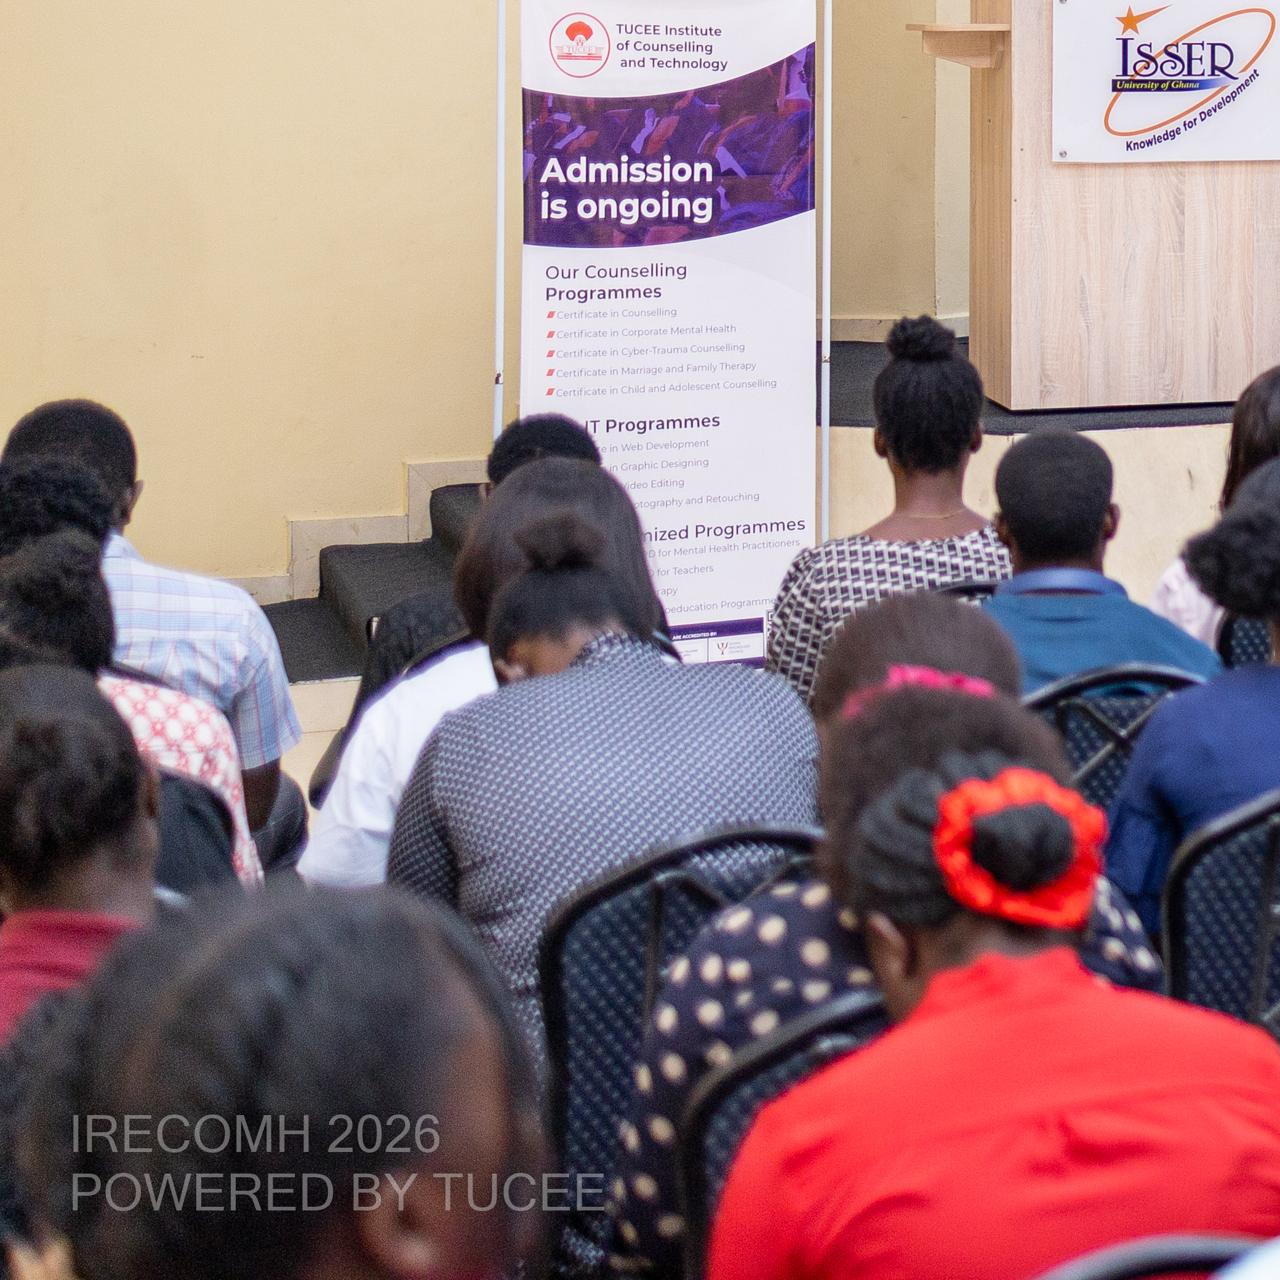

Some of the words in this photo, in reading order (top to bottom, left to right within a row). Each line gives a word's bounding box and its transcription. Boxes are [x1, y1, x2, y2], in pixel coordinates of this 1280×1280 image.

[616, 24, 660, 35] TUCEE
[666, 25, 721, 36] Institute
[617, 40, 629, 50] of
[634, 41, 712, 55] Counselling
[621, 57, 645, 67] and
[650, 58, 727, 71] Technology
[1116, 37, 1240, 80] ISSER
[1116, 80, 1159, 91] University
[1161, 80, 1170, 91] of
[1171, 80, 1200, 89] Ghana
[1126, 126, 1182, 152] Knowledge
[1183, 117, 1198, 131] for
[1199, 69, 1260, 122] Development
[540, 155, 712, 183] Admission
[541, 191, 568, 219] is
[577, 190, 712, 224] ongoing
[546, 266, 579, 279] Our
[585, 263, 686, 279] Counselling
[546, 288, 661, 303] Programmes
[557, 310, 608, 319] Certificate
[622, 307, 677, 318] Counselling
[556, 330, 607, 339] Certificate
[622, 328, 668, 337] Corporate
[671, 325, 703, 335] Mental
[706, 324, 736, 333] Health
[556, 349, 607, 358] Certificate
[610, 348, 618, 356] in
[622, 346, 688, 357] Cyber-Trauma
[690, 344, 745, 352] Counselling
[556, 368, 607, 377] Certificate
[621, 367, 663, 376] Marriage
[666, 364, 683, 373] and
[687, 363, 717, 373] Family
[720, 363, 756, 371] Therapy
[556, 387, 607, 397] Certificate
[610, 386, 618, 395] in
[621, 384, 645, 394] Child
[648, 384, 665, 392] and
[669, 382, 720, 391] Adolescent
[723, 379, 777, 391] Counselling
[606, 417, 720, 434] Programmes
[610, 444, 618, 453] in
[621, 442, 643, 452] Web
[646, 440, 708, 450] Development
[609, 464, 619, 472] in
[621, 461, 658, 472] Graphic
[661, 458, 709, 469] Designing
[651, 480, 684, 488] Editing
[685, 496, 703, 504] and
[706, 492, 759, 503] Retouching
[696, 520, 805, 539] Programmes
[658, 549, 671, 557] for
[674, 546, 706, 556] Mental
[709, 543, 739, 552] Health
[742, 540, 800, 550] Practitioners
[657, 568, 670, 576] for
[672, 565, 714, 575] Teachers
